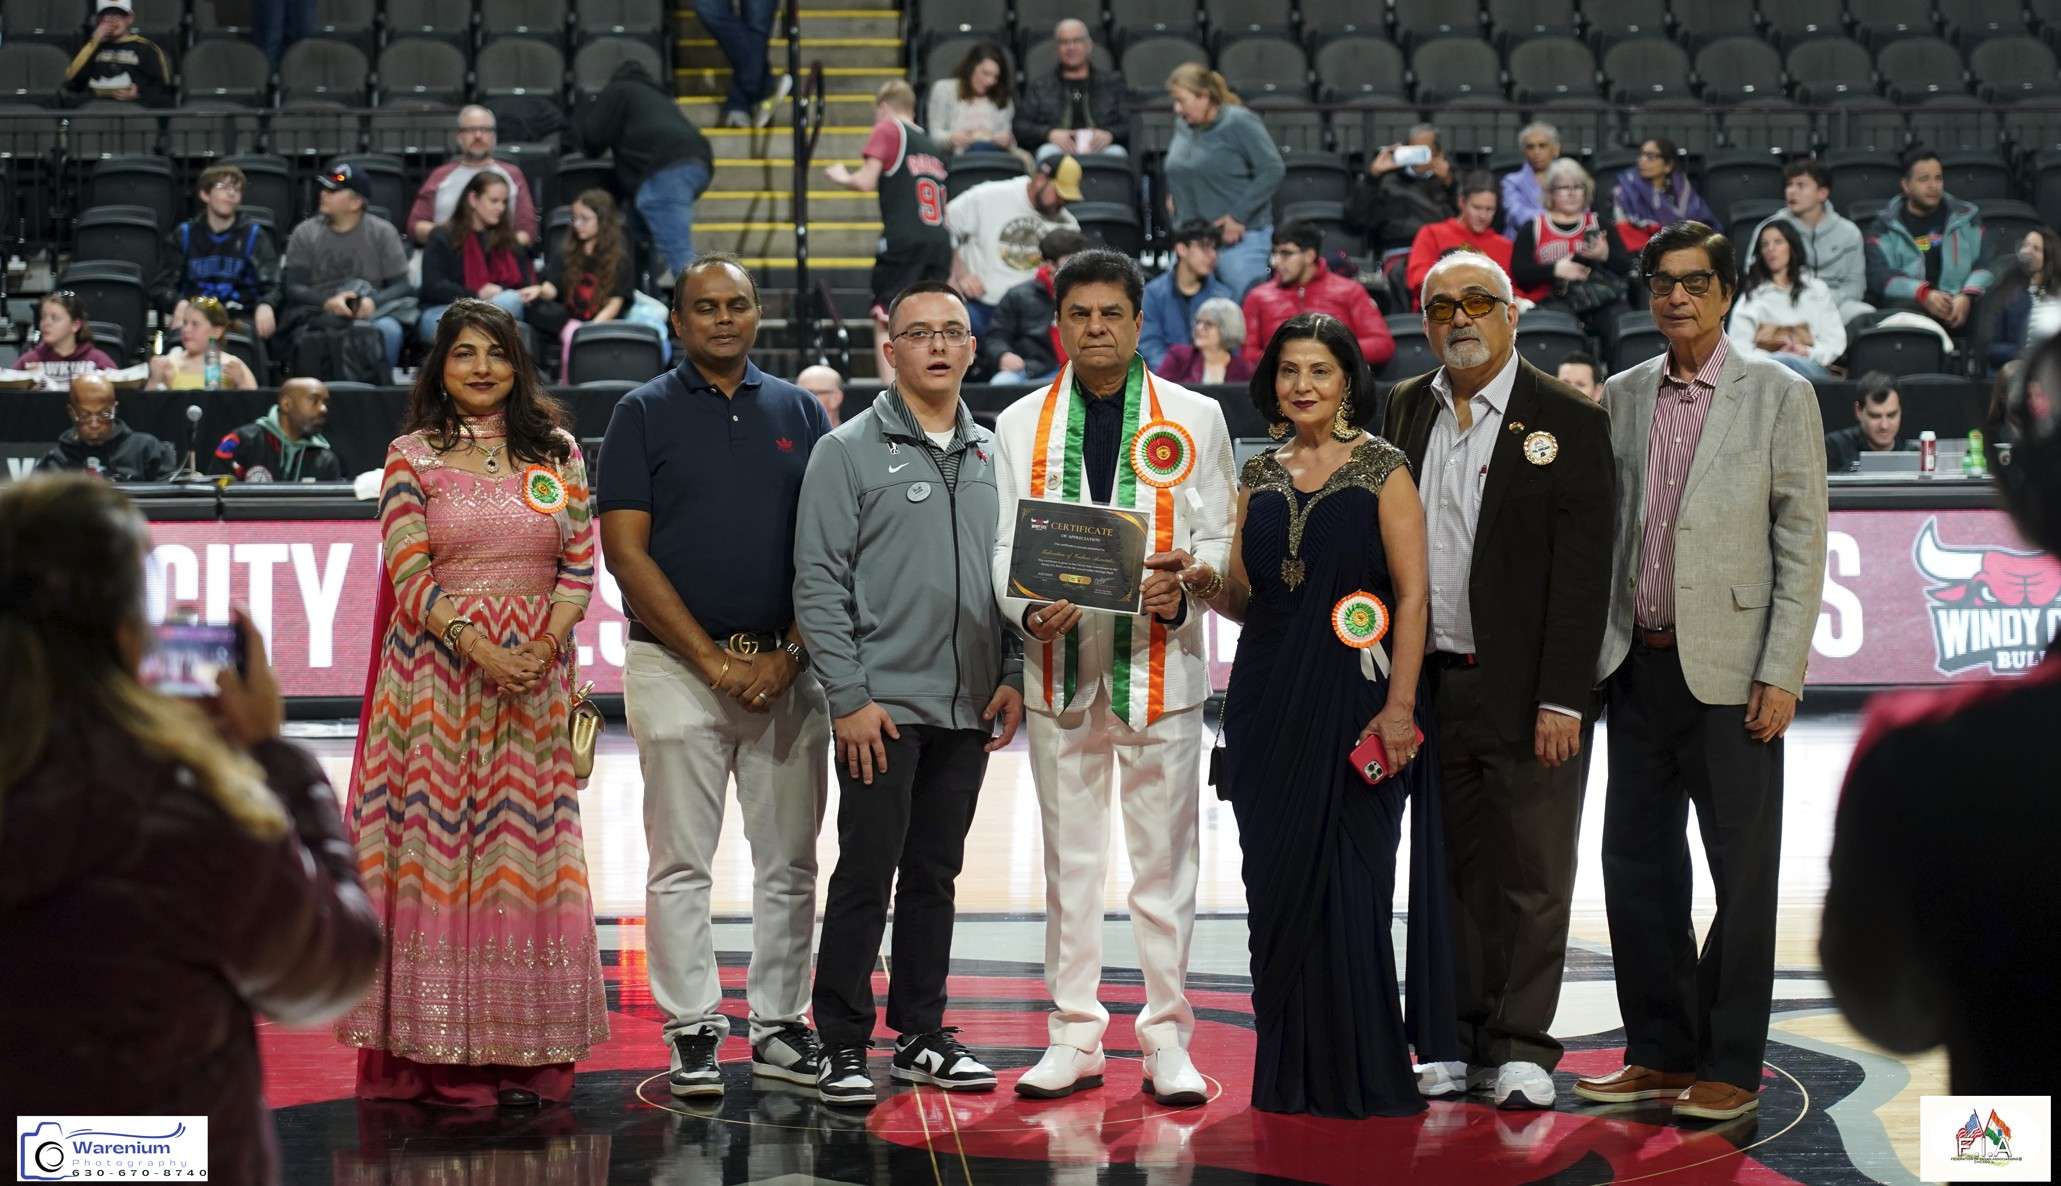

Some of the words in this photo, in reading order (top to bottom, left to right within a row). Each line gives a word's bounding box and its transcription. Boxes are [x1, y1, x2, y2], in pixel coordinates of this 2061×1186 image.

[1051, 522, 1113, 537] CERTIFICATE
[145, 543, 353, 667] CITY
[1936, 608, 2041, 659] WINDY
